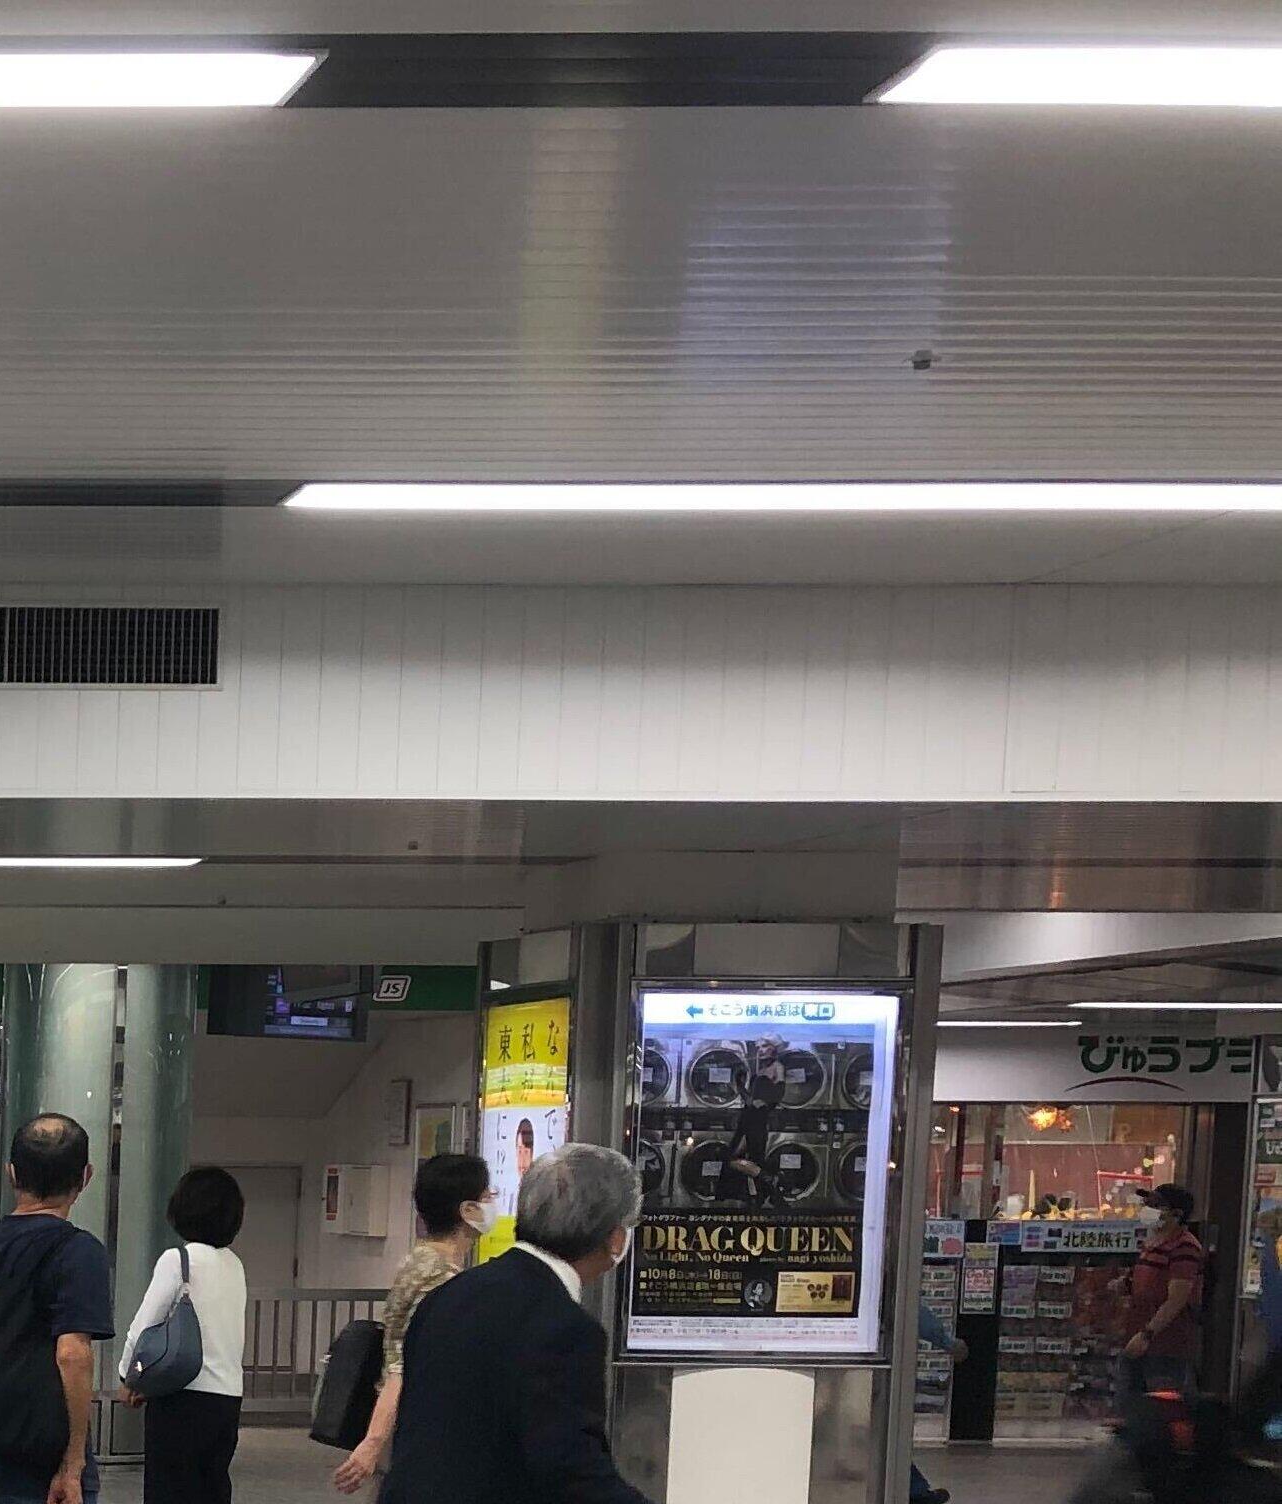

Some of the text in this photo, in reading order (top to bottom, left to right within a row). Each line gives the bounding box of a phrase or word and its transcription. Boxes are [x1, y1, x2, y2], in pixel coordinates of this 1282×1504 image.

[382, 983, 401, 994] JS
[642, 1226, 854, 1256] DRAG QUEEN
[1063, 1230, 1132, 1249] 北陸旅行
[713, 1252, 749, 1263] Queen
